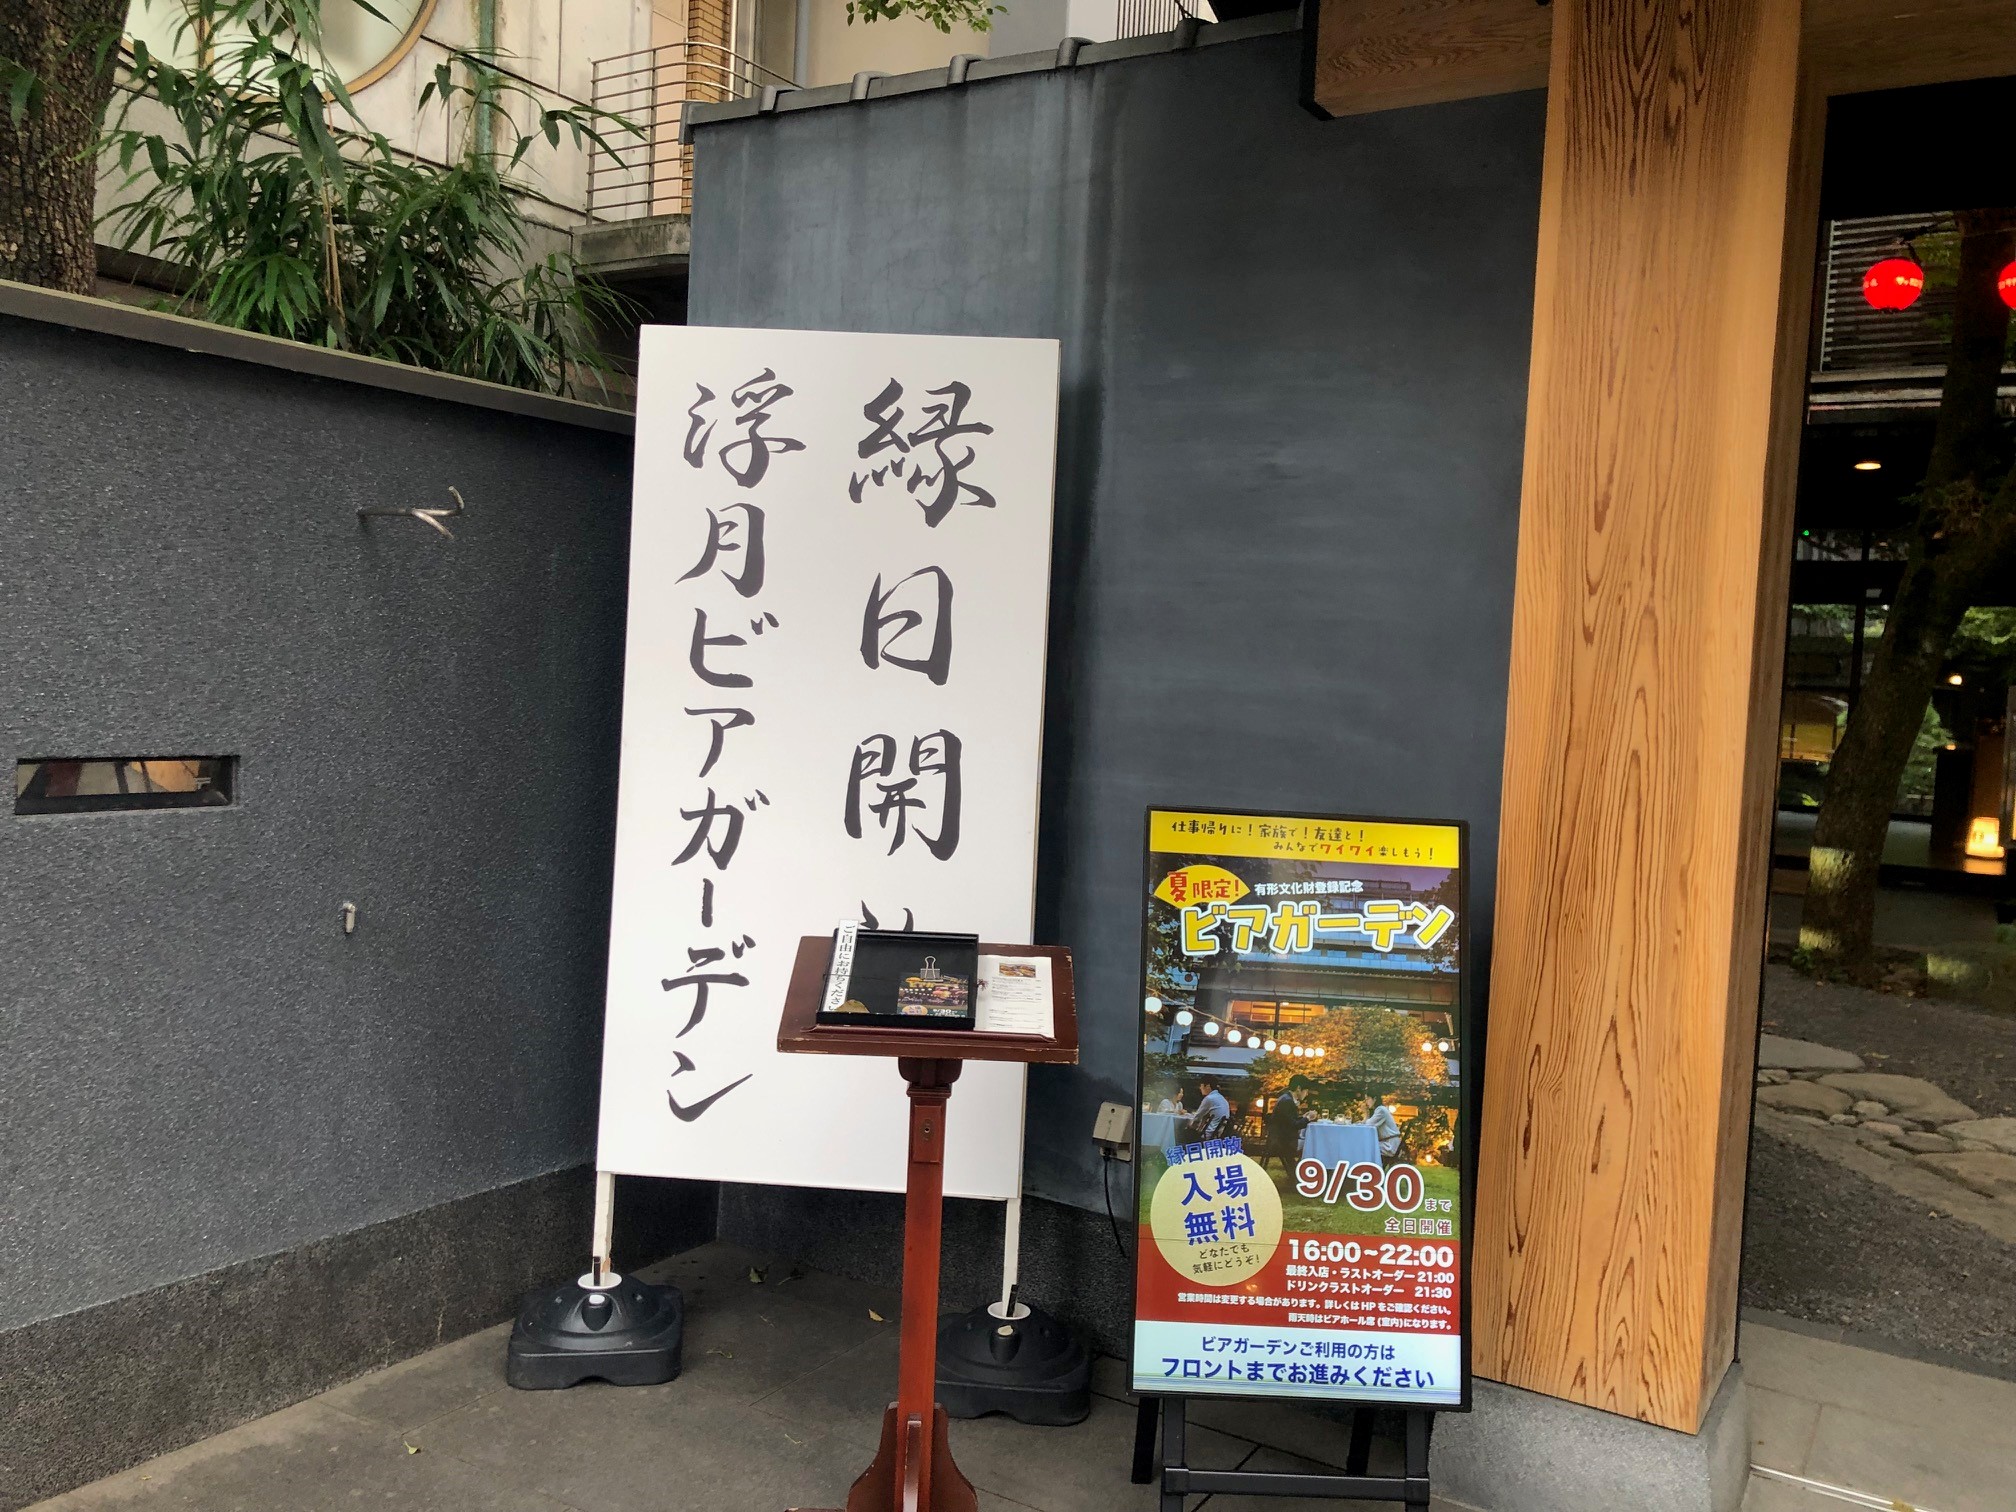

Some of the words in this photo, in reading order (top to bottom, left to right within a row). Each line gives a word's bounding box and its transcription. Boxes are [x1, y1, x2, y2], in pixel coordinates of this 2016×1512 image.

[842, 376, 998, 934] 縁日開
[661, 366, 807, 1124] 浮月ビアガーデン
[1254, 880, 1364, 896] 有形文化財登録記念
[1181, 900, 1455, 956] ビアガーデン
[1166, 1136, 1244, 1166] 縁日開放
[1181, 1164, 1249, 1206] 入場
[1184, 1202, 1255, 1246] 無料
[1384, 1217, 1453, 1236] 全日開催
[1199, 1243, 1250, 1260] どなたでも
[1414, 1286, 1452, 1299] 21:30
[1417, 1271, 1455, 1284] 21:00
[1202, 1335, 1396, 1361] ビアガーデンご利用の方は
[1161, 1357, 1434, 1390] フロントまでお進みください
